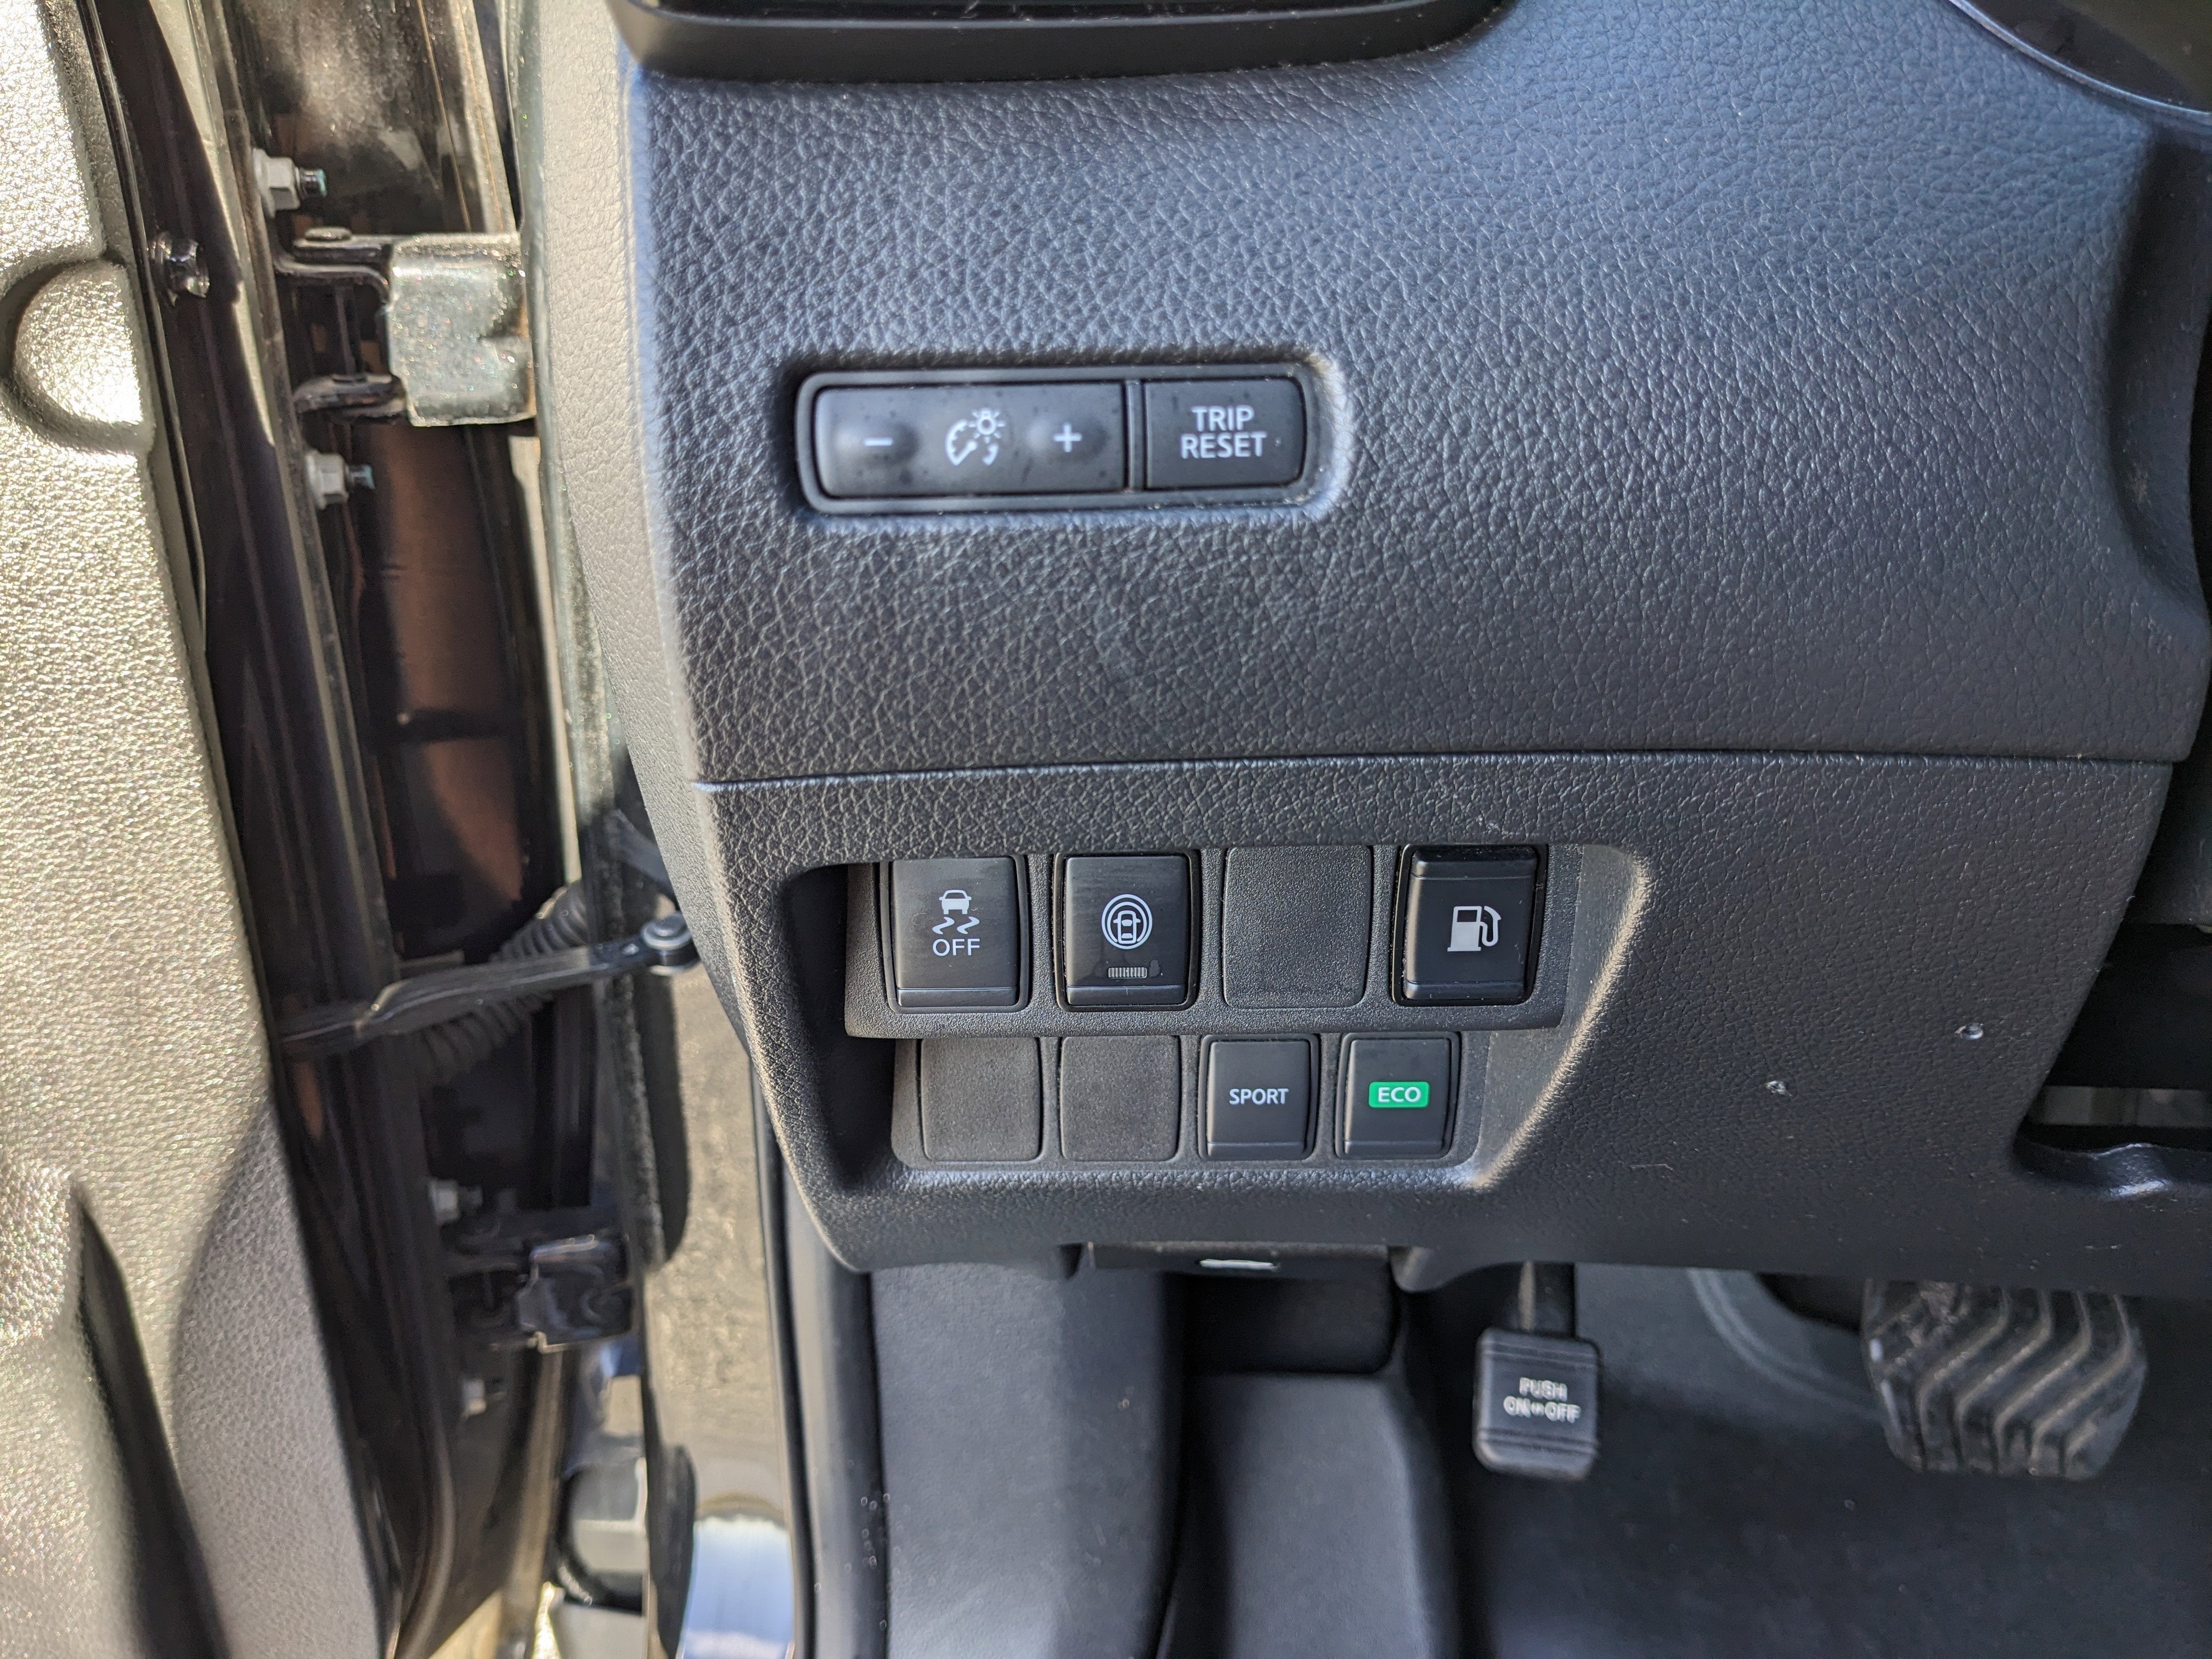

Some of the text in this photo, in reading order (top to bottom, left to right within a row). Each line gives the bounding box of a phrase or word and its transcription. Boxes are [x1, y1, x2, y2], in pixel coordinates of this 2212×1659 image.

[1190, 405, 1254, 431] TRIP
[1181, 432, 1267, 459] RESET
[933, 938, 980, 957] OFF
[1229, 1088, 1289, 1105] SPORT
[1378, 1086, 1421, 1103] ECO
[1519, 1377, 1567, 1401] PUSH
